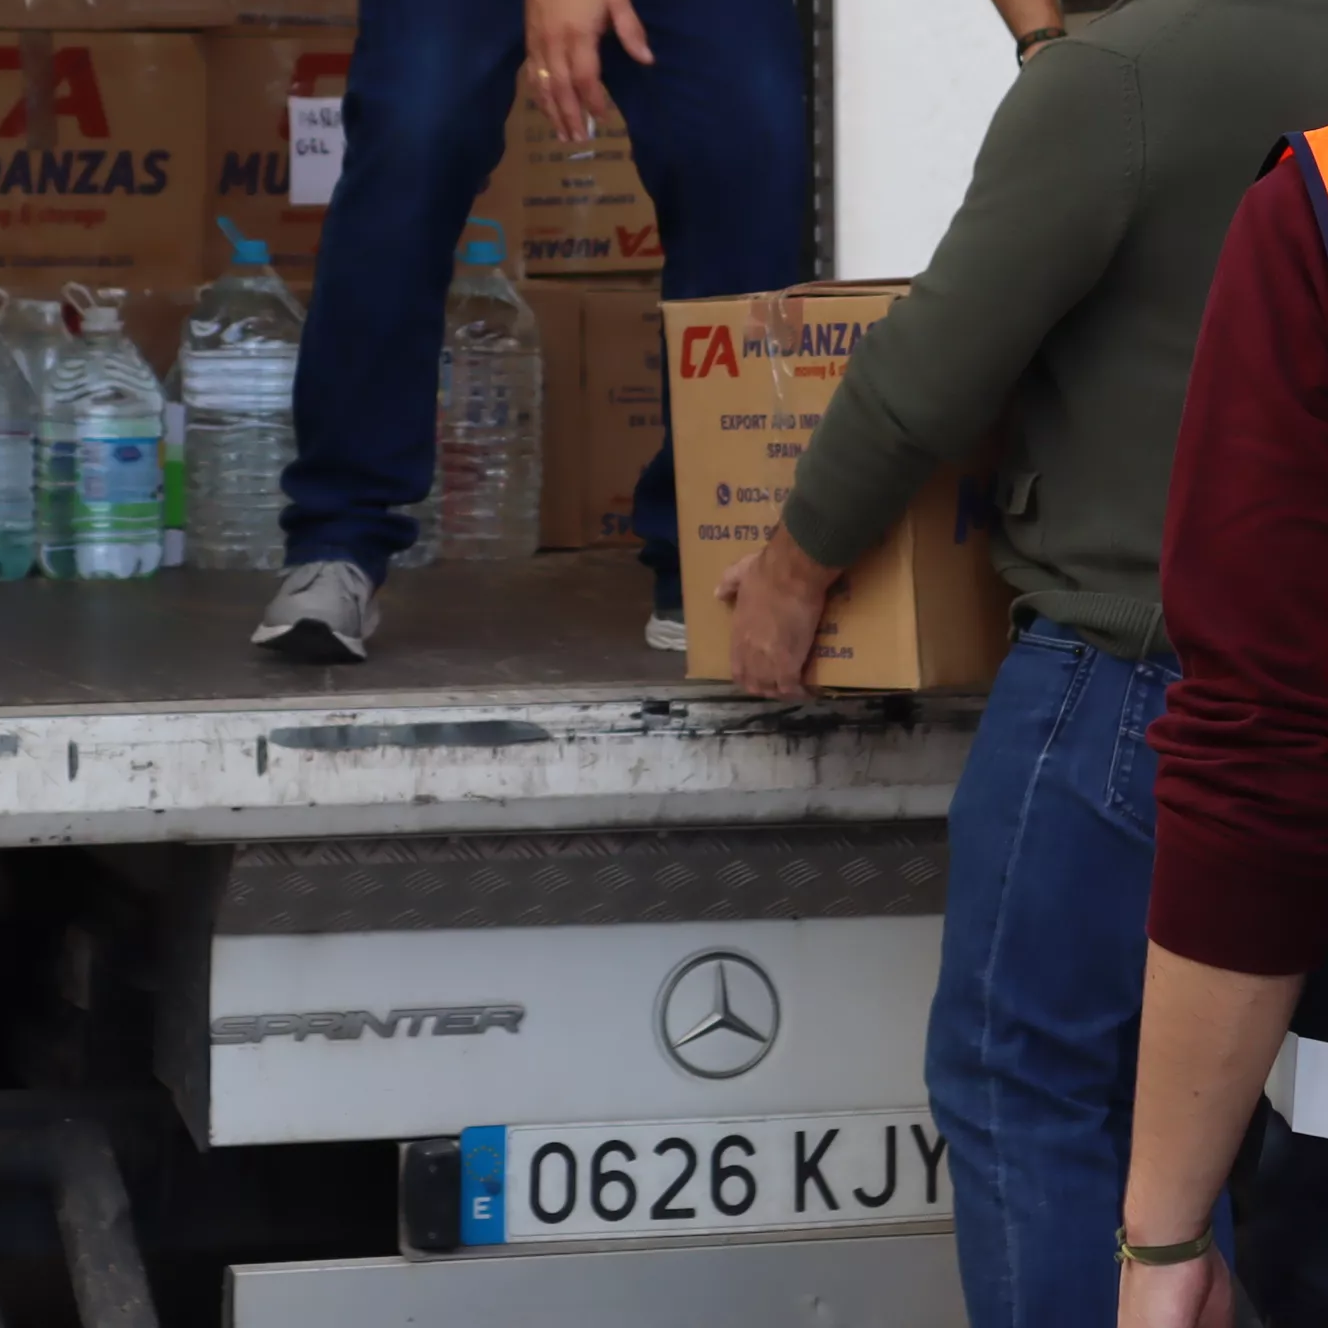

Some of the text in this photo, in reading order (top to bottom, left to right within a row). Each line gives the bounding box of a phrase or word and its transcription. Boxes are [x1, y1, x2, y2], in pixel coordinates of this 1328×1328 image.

[680, 325, 740, 379] CA
[720, 414, 766, 430] EXPORT
[698, 525, 731, 541] 0034
[734, 524, 759, 540] 679
[210, 1003, 525, 1045] SPRINTER
[472, 1194, 492, 1220] E
[529, 1134, 758, 1224] 0626
